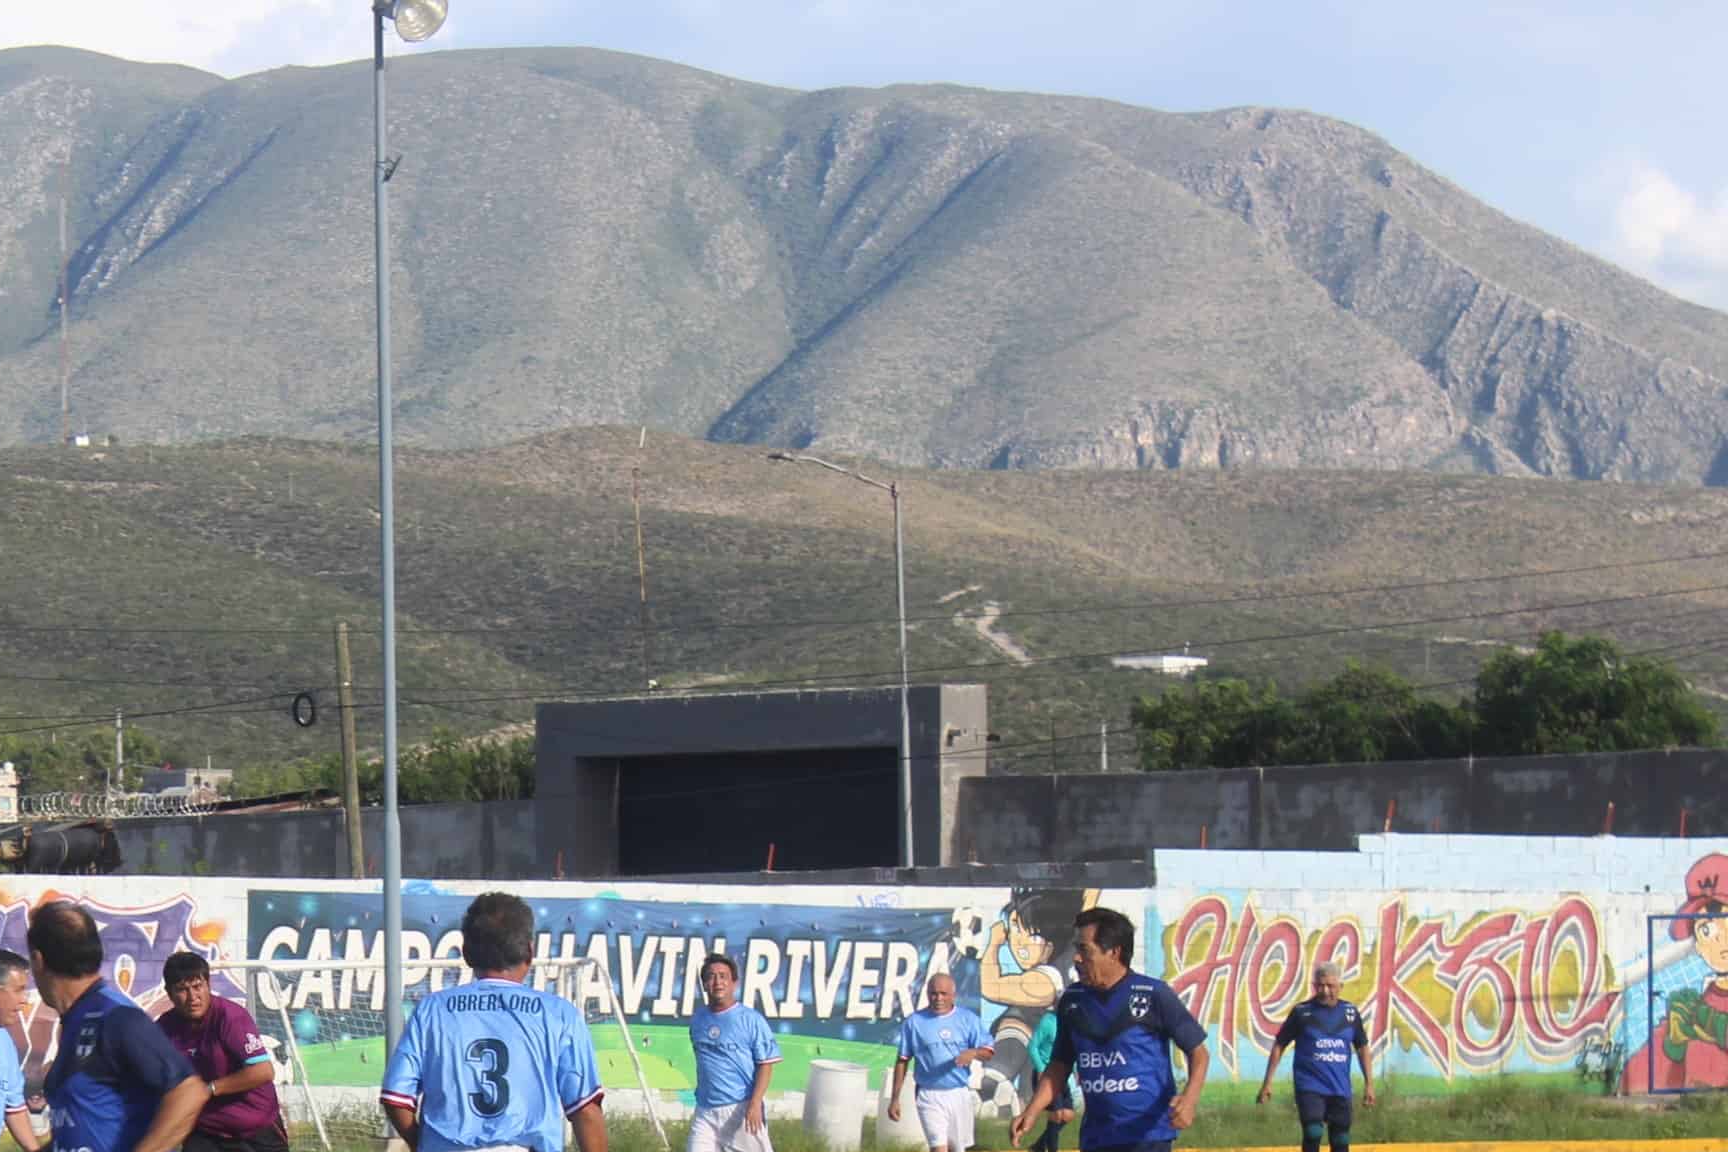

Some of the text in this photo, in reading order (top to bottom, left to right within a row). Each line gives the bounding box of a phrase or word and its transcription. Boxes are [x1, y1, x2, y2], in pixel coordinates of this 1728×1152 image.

[533, 932, 727, 1016] HAVIN
[446, 992, 542, 1015] OBRERA ORO
[1079, 1050, 1127, 1069] BBVA
[464, 1037, 511, 1119] 3
[1080, 1073, 1140, 1094] odere
